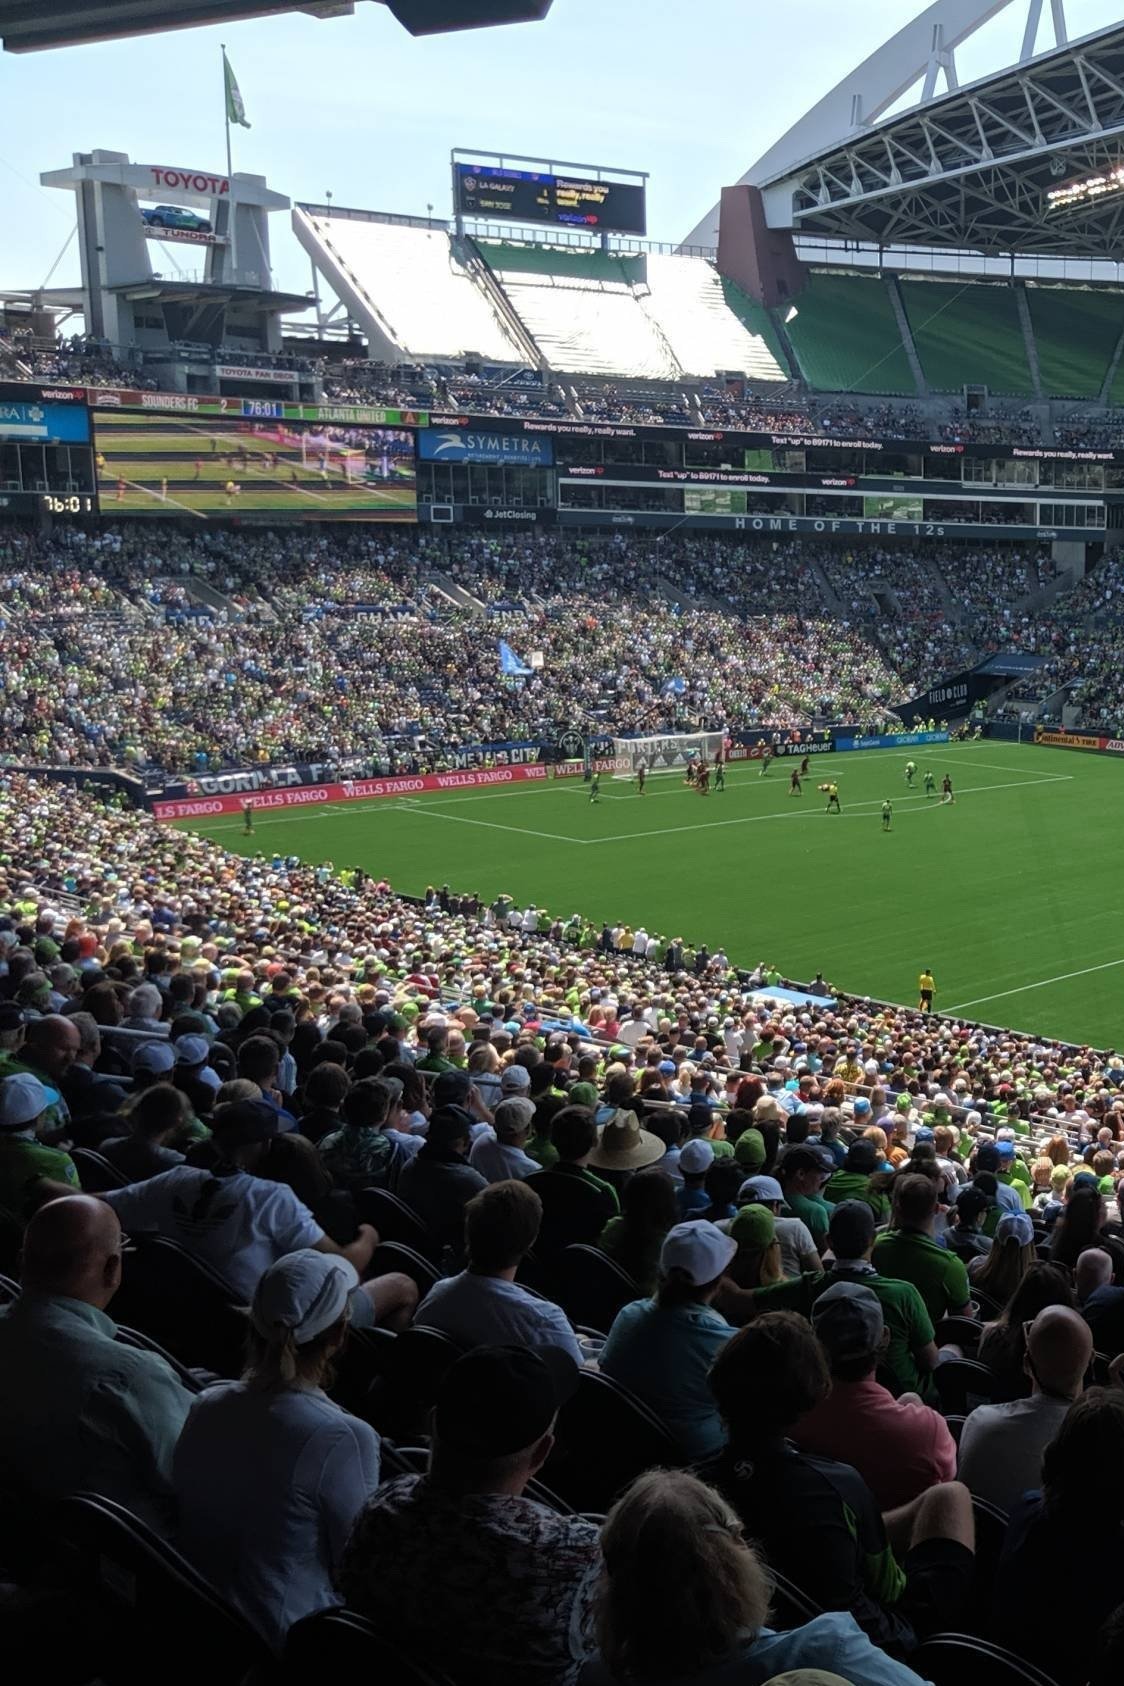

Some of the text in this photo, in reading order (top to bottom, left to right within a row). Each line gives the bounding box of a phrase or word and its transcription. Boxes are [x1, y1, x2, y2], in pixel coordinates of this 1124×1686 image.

[151, 168, 230, 194] TOYOTA
[163, 228, 217, 242] TUNDRA
[221, 367, 252, 377] TOYOTA
[142, 394, 185, 409] SOUNDERS
[187, 397, 198, 410] FC
[220, 399, 227, 414] 2
[249, 401, 277, 417] 76:01
[318, 407, 355, 422] ATLANTA
[357, 409, 386, 423] UNITED
[524, 421, 557, 432] Rewards
[557, 425, 572, 433] you
[572, 425, 594, 435] really,
[594, 427, 614, 437] really
[467, 435, 542, 453] SYMETRA
[771, 436, 787, 444] Text
[1013, 448, 1043, 457] Rewards
[1078, 451, 1096, 460] really
[658, 470, 674, 478] Text
[44, 496, 91, 512] 76:01
[493, 510, 536, 520] JetClosing
[735, 518, 945, 536] HOME OF THE 12s
[929, 688, 946, 704] FIELD
[953, 683, 968, 698] CLUB
[1082, 739, 1097, 747] TIRE
[511, 747, 541, 763] CITY
[595, 758, 630, 771] FARGO
[437, 770, 513, 787] WELLS FARGO
[342, 779, 424, 797] WELLS FARGO
[240, 789, 328, 809] WELLS FARGO
[177, 801, 223, 816] FARGO
